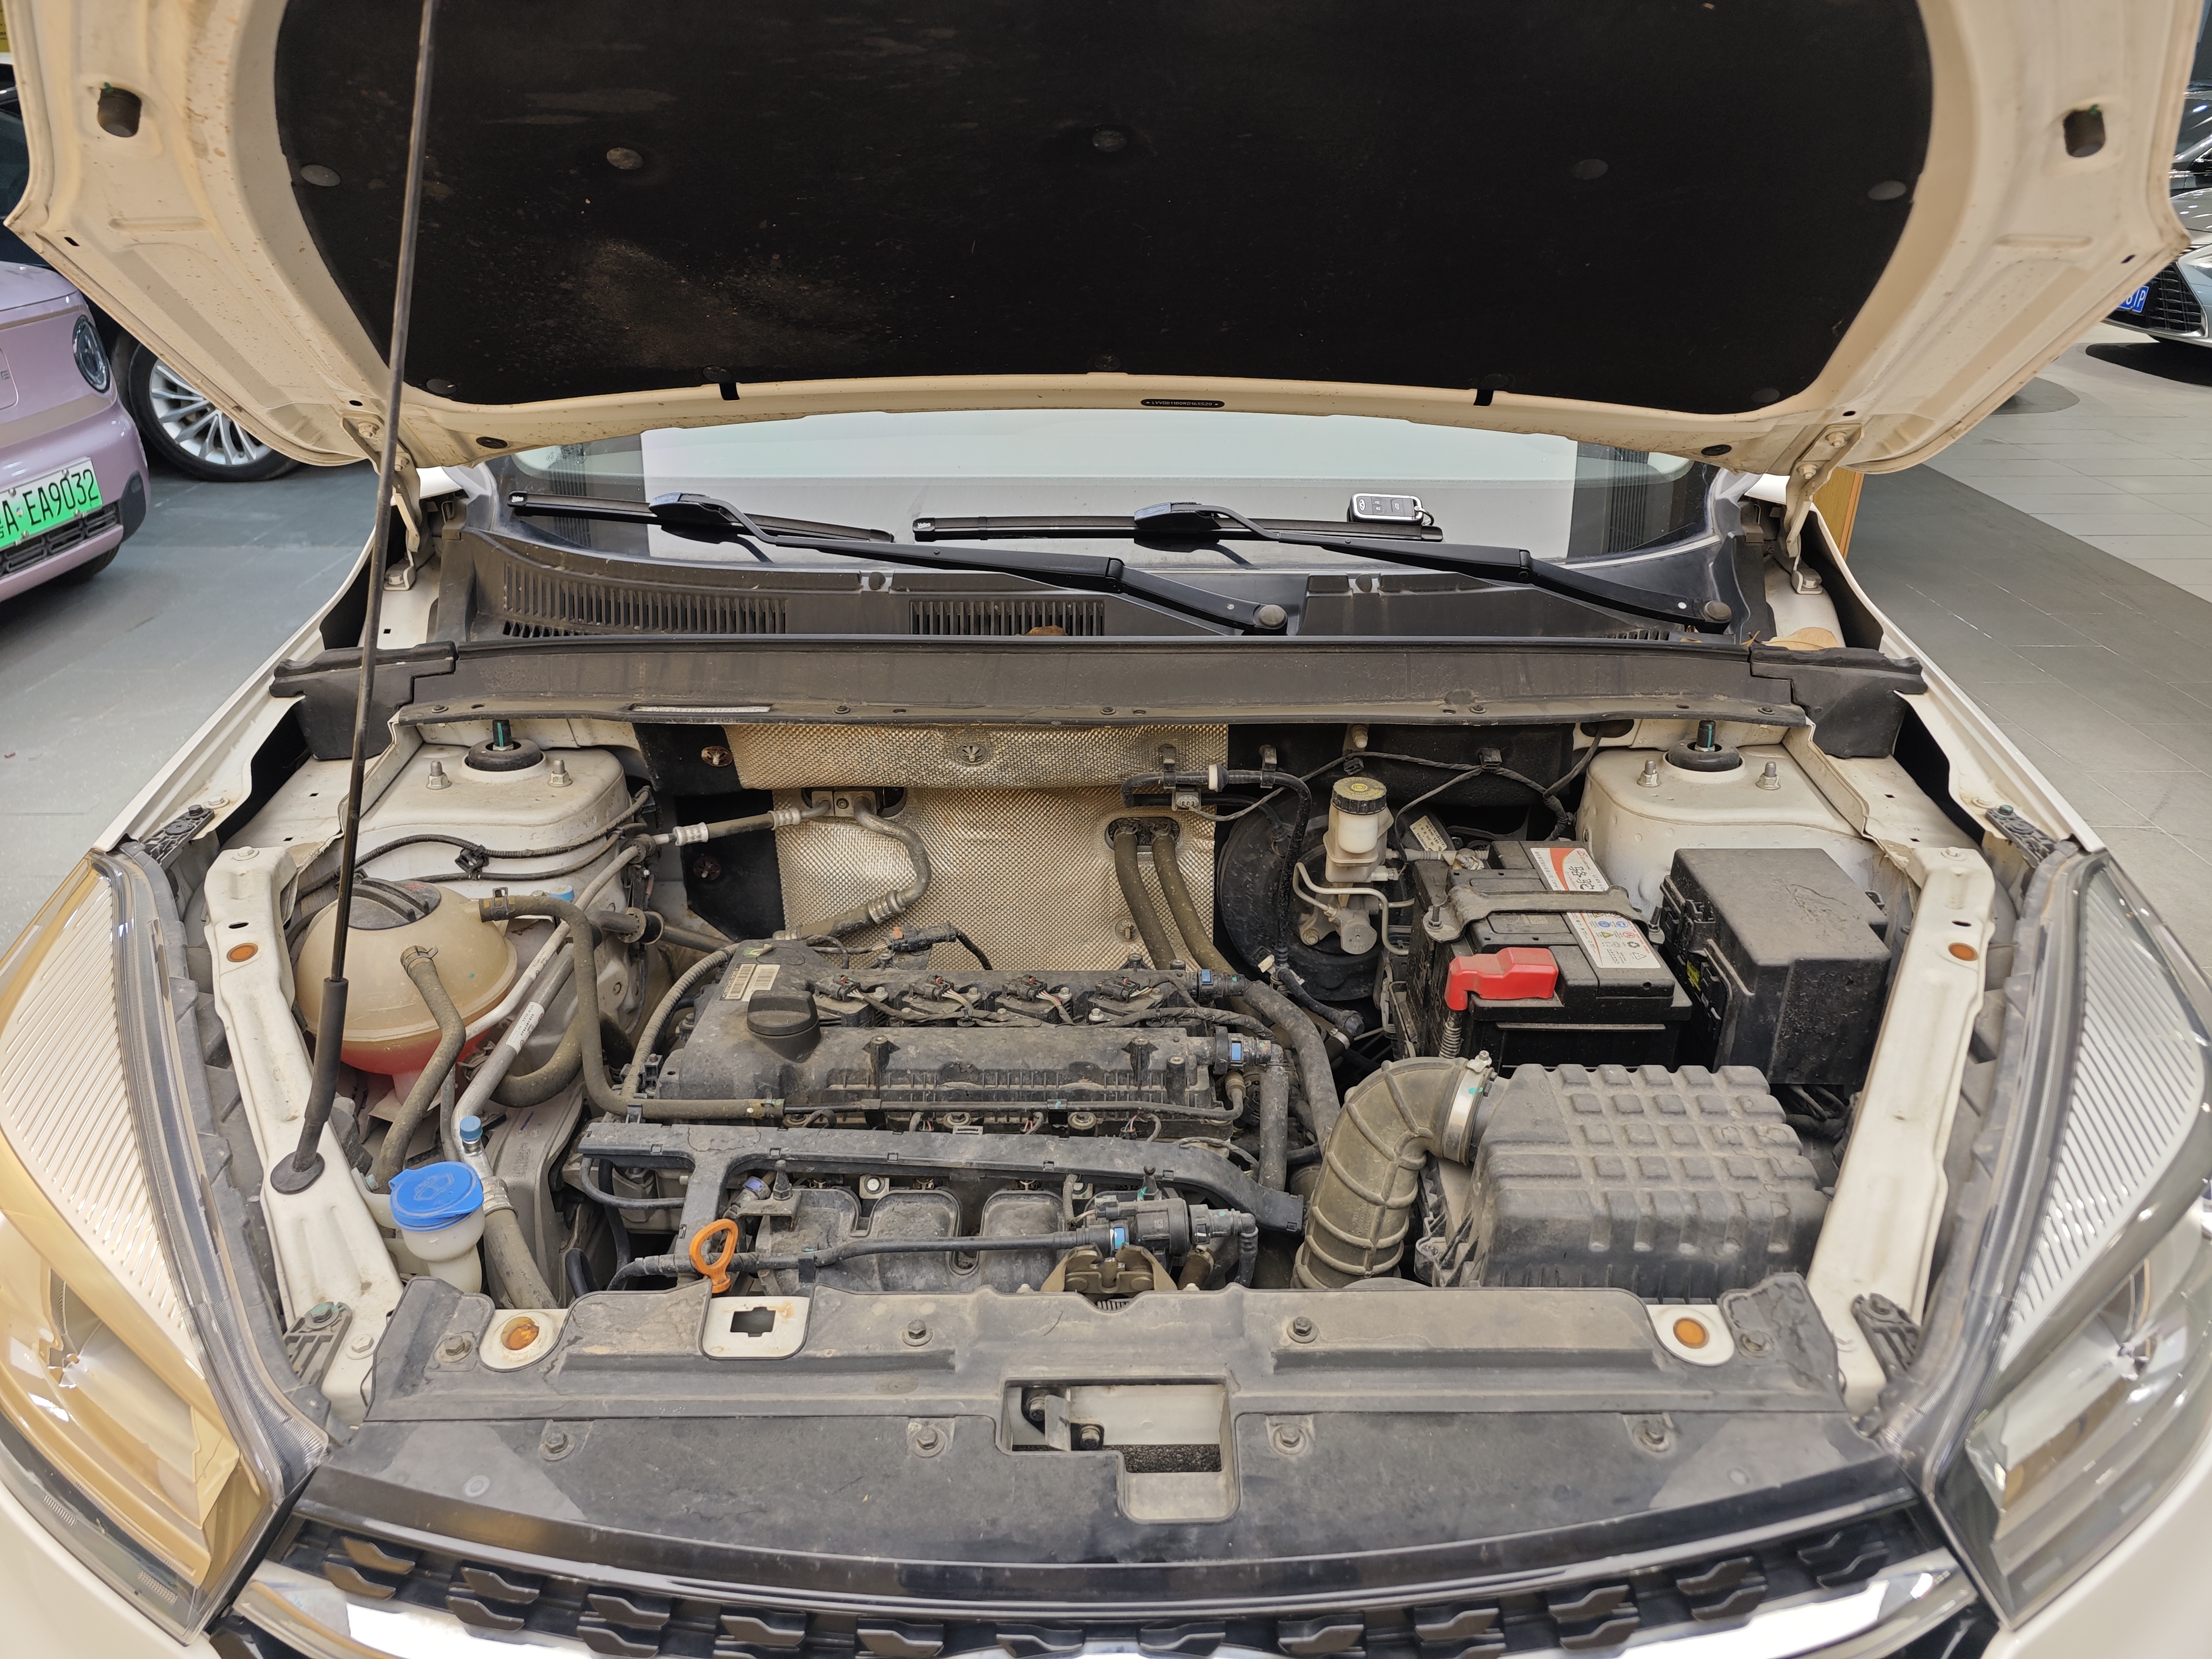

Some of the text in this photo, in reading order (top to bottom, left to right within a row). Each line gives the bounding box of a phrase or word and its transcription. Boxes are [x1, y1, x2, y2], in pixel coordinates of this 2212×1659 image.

[0, 468, 99, 538] A EA9032
[1568, 866, 1595, 891] 骆驼
